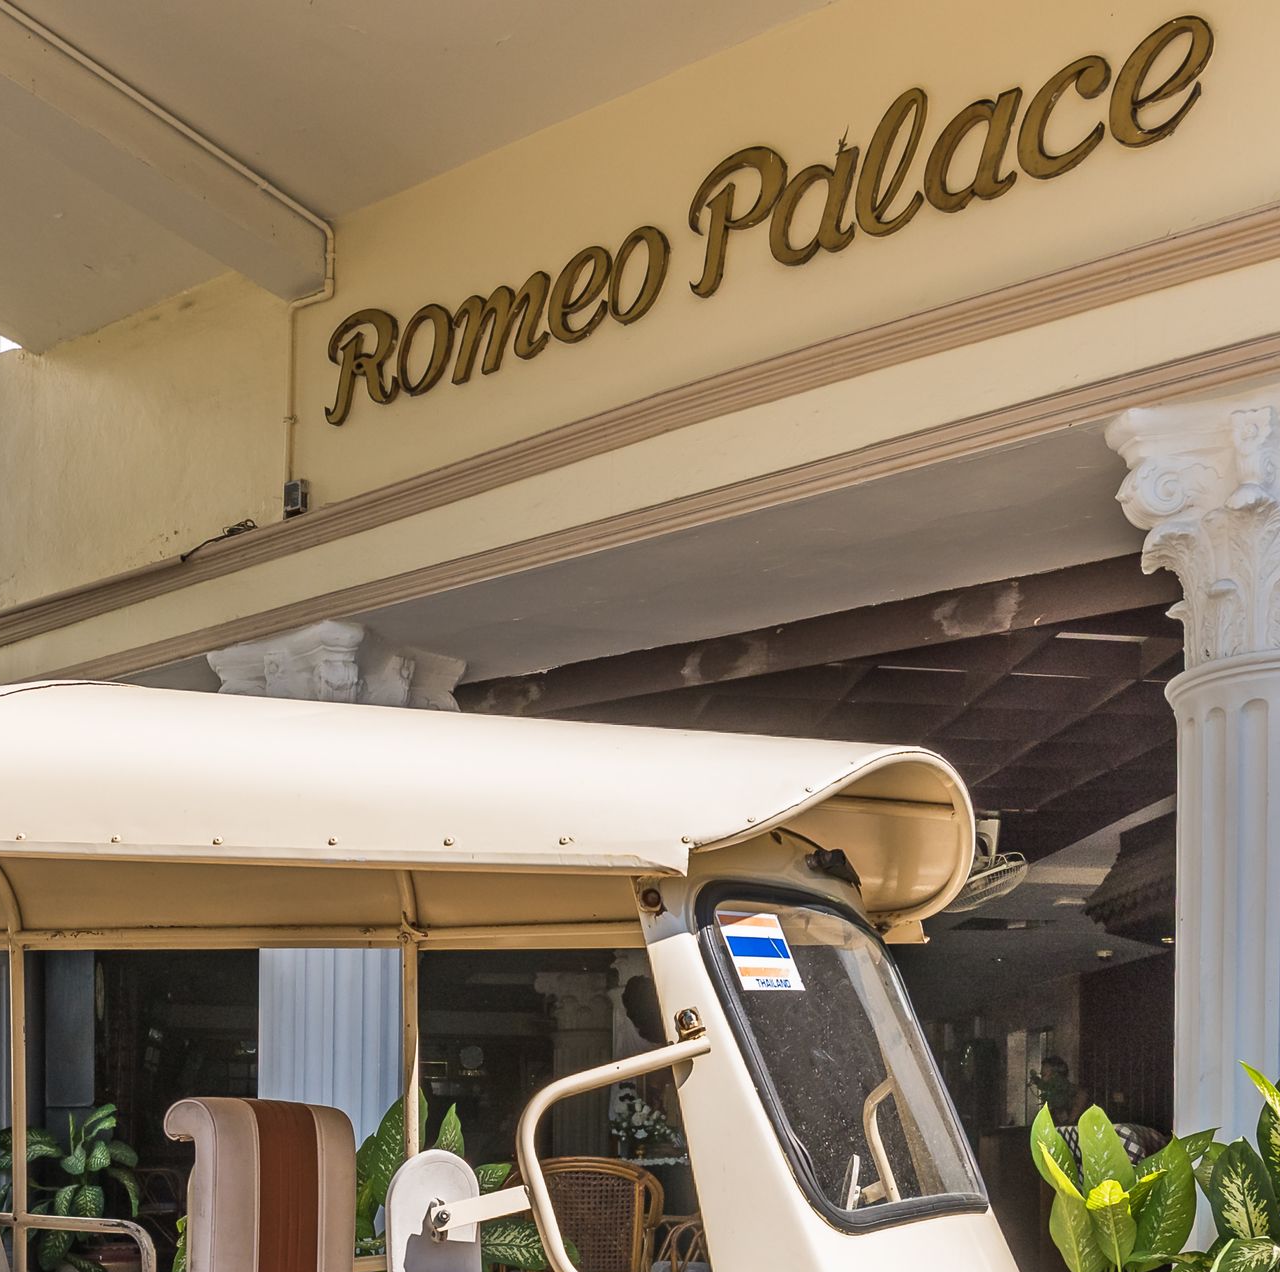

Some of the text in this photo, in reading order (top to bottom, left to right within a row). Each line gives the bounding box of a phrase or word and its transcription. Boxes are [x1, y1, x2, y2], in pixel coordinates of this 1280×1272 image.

[325, 14, 1215, 427] Romeo Palace
[756, 978, 791, 988] THAILAND
